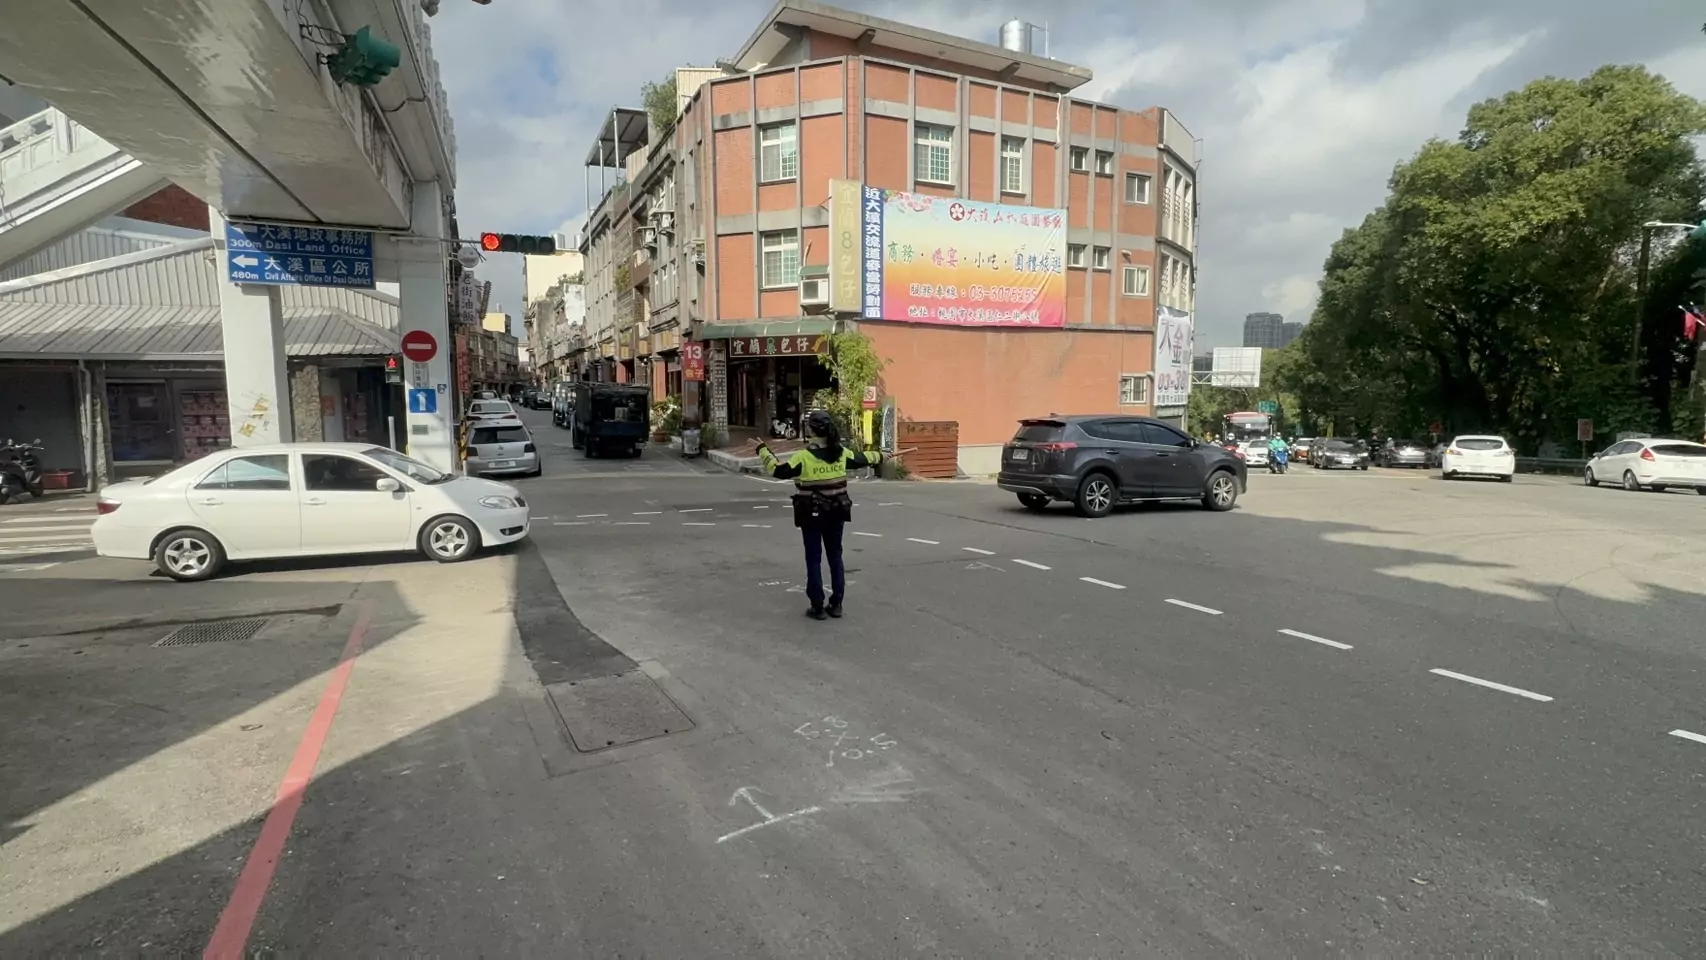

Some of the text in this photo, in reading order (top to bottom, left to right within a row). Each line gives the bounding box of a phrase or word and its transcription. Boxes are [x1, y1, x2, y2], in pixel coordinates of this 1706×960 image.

[260, 224, 368, 246] 大溪地政事務所
[230, 238, 366, 255] 300m Dasi Land Office
[263, 256, 370, 276] 大溪區公所
[231, 272, 259, 280] 480m
[264, 272, 279, 281] Civil
[304, 274, 323, 283] Office
[461, 270, 475, 322] 老街油飯
[685, 345, 702, 359] 13
[813, 464, 845, 474] POLICE
